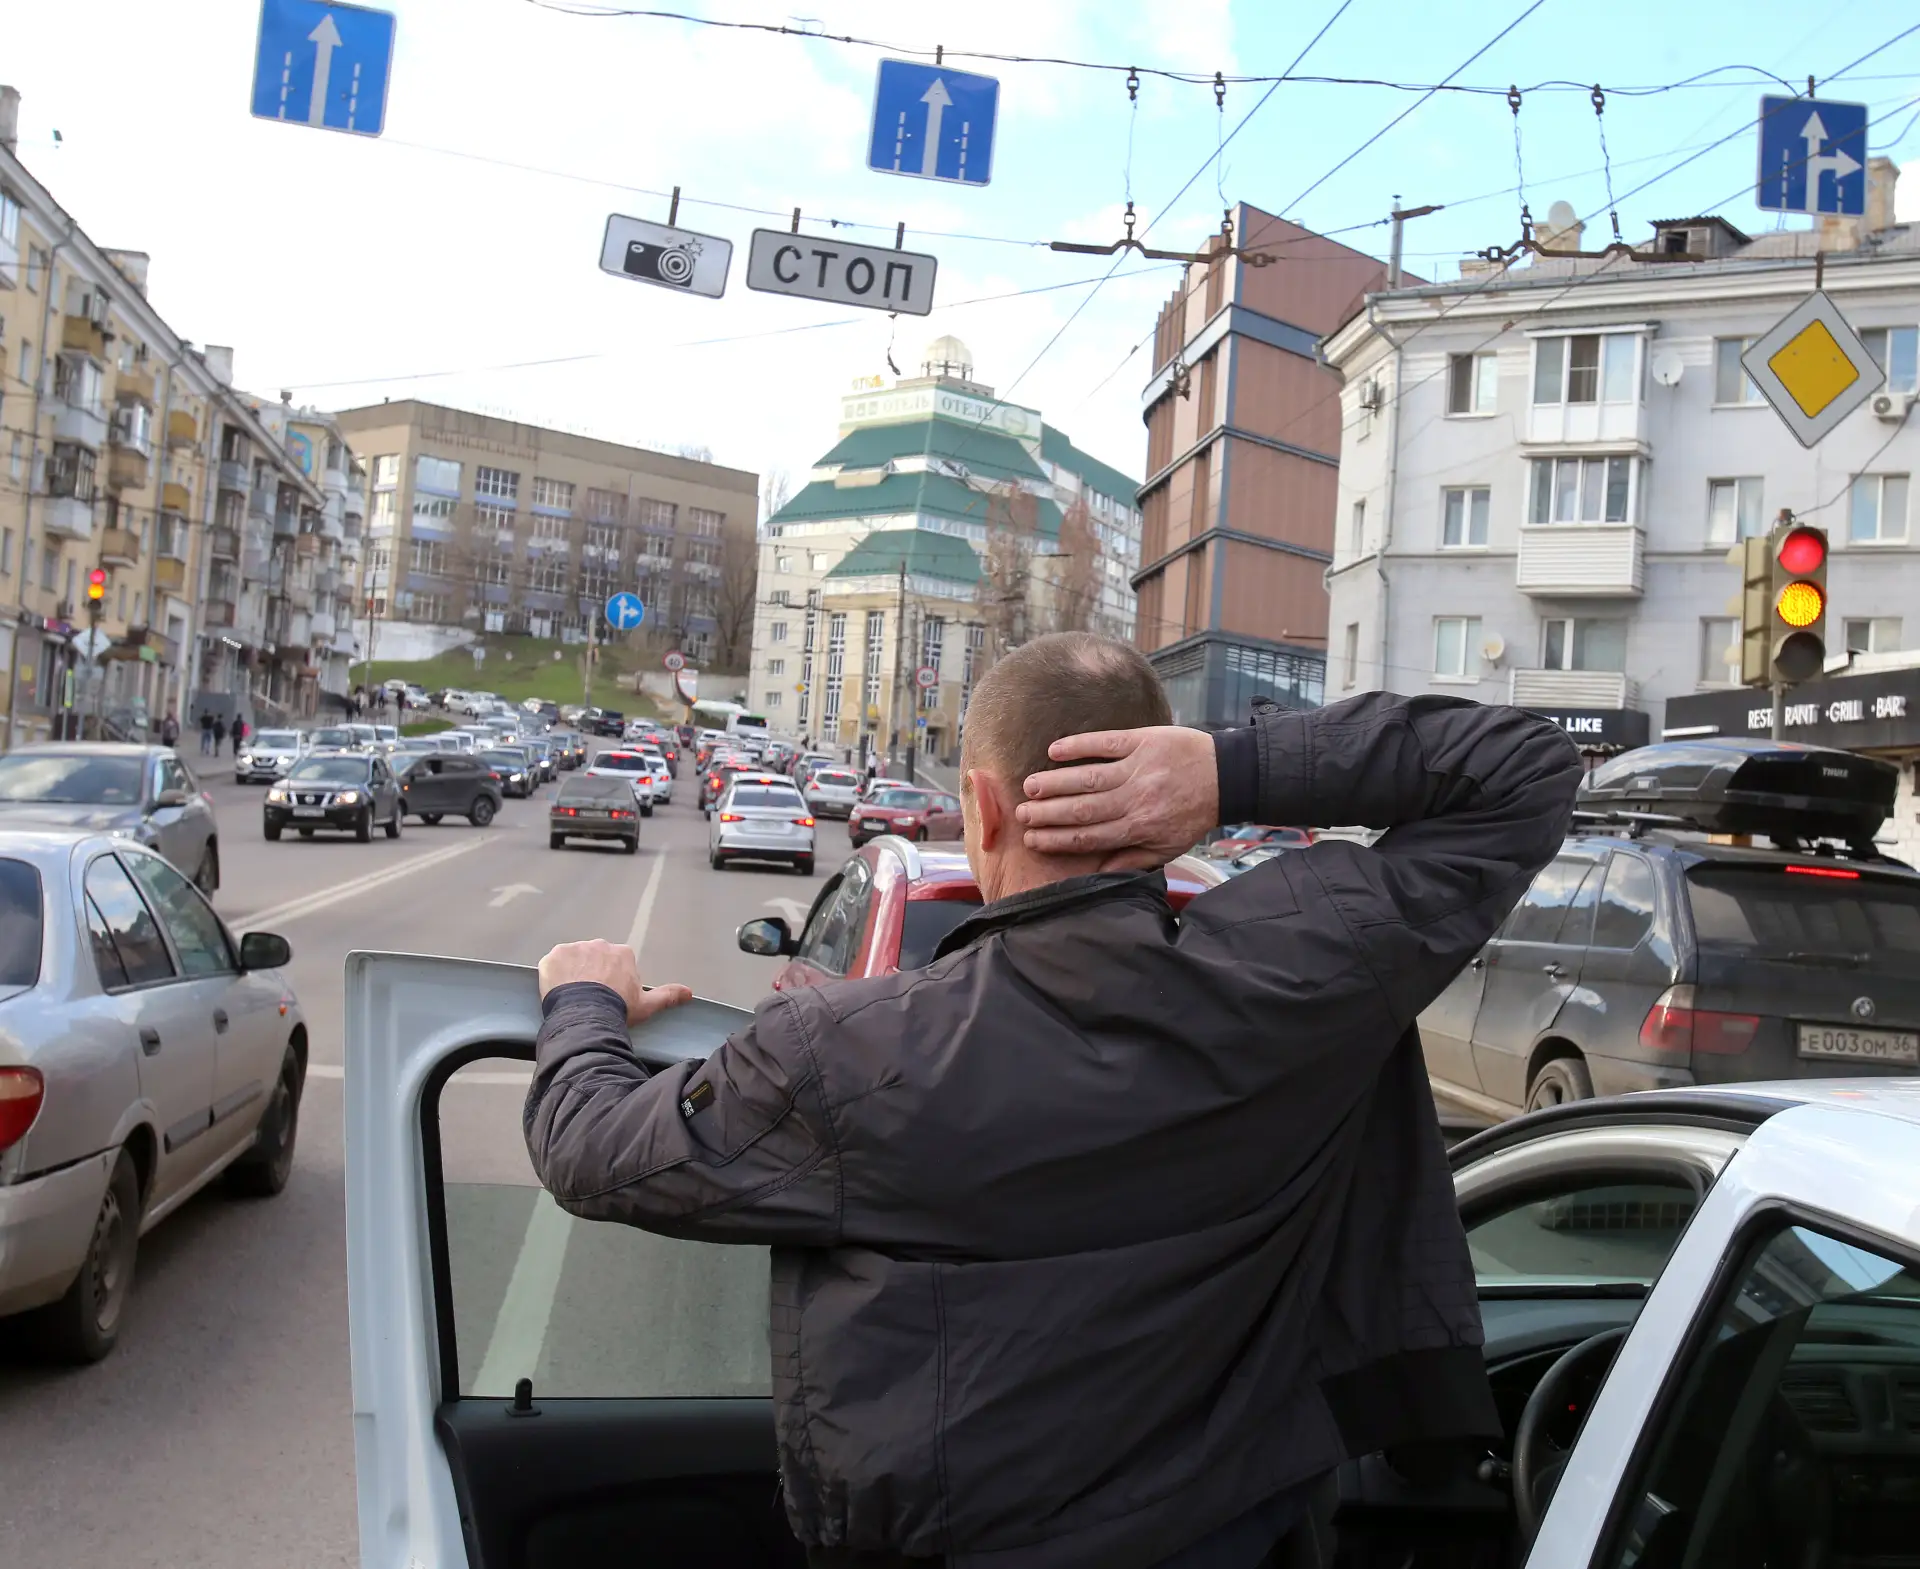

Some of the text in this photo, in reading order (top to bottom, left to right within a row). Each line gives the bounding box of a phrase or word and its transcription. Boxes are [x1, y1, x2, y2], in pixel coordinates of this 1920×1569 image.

[773, 245, 912, 301] СТОП
[883, 395, 929, 413] ОТЕЛЬ
[942, 396, 992, 421] ОТЕЛЬ
[667, 657, 681, 667] 40
[920, 672, 933, 682] 40
[1748, 704, 1819, 729] RESTRANT
[1876, 696, 1906, 718] BAR
[1566, 717, 1603, 733] LIKE
